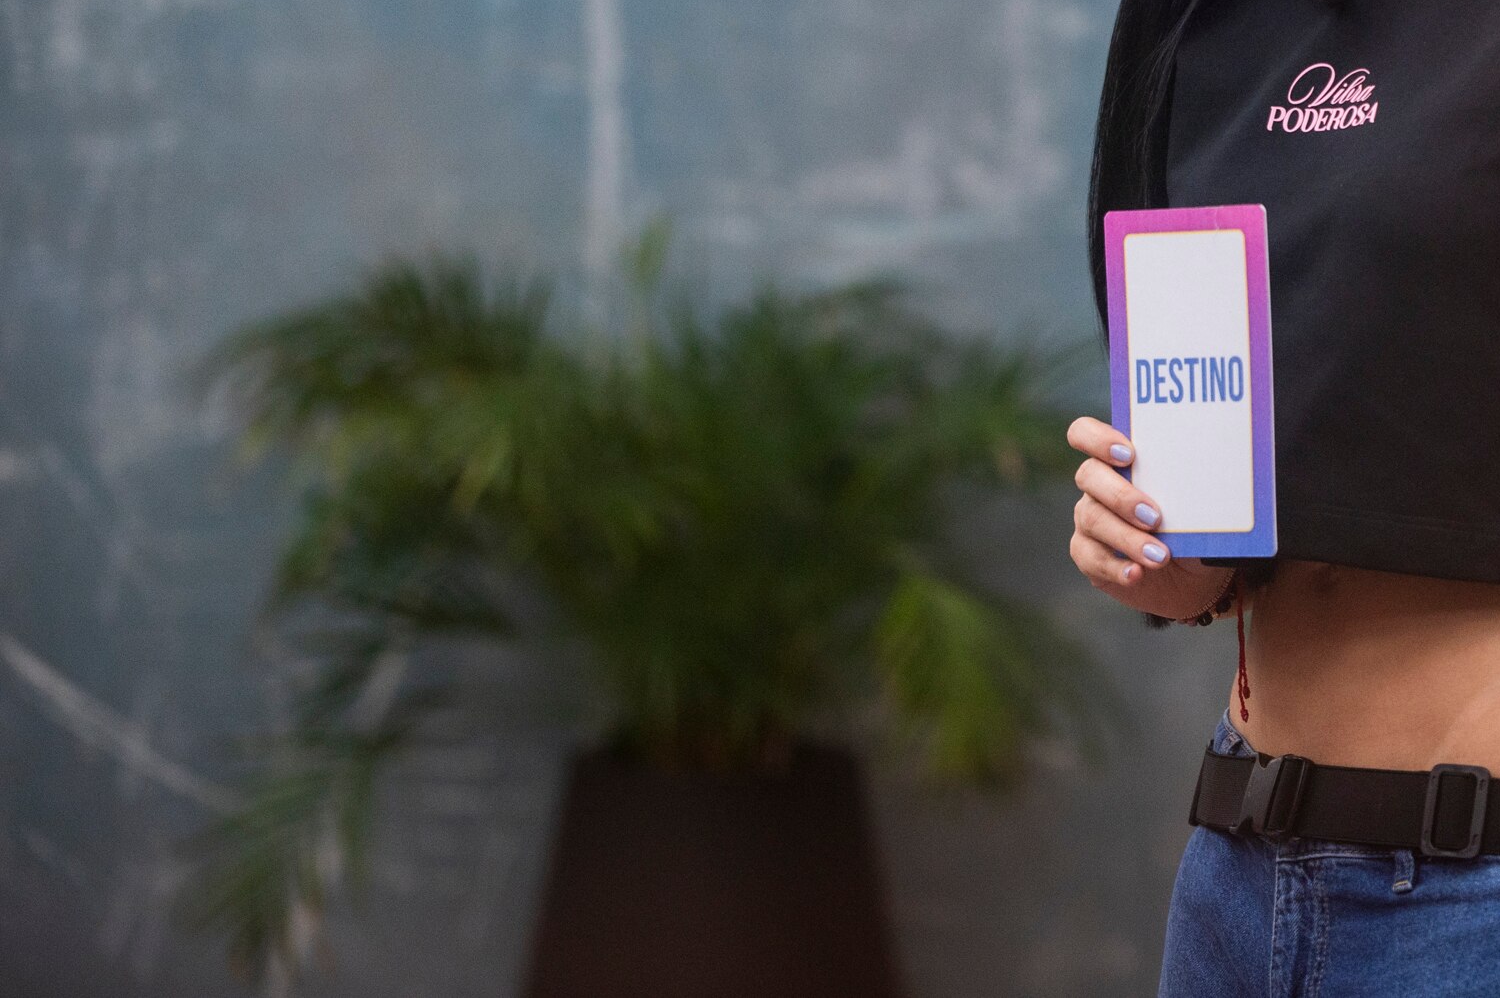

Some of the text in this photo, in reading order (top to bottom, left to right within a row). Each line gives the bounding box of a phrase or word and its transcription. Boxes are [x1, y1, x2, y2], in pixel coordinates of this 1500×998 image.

[1288, 63, 1375, 107] Vibra
[1266, 102, 1378, 133] PODEROSA
[1136, 357, 1245, 404] DESTINO
